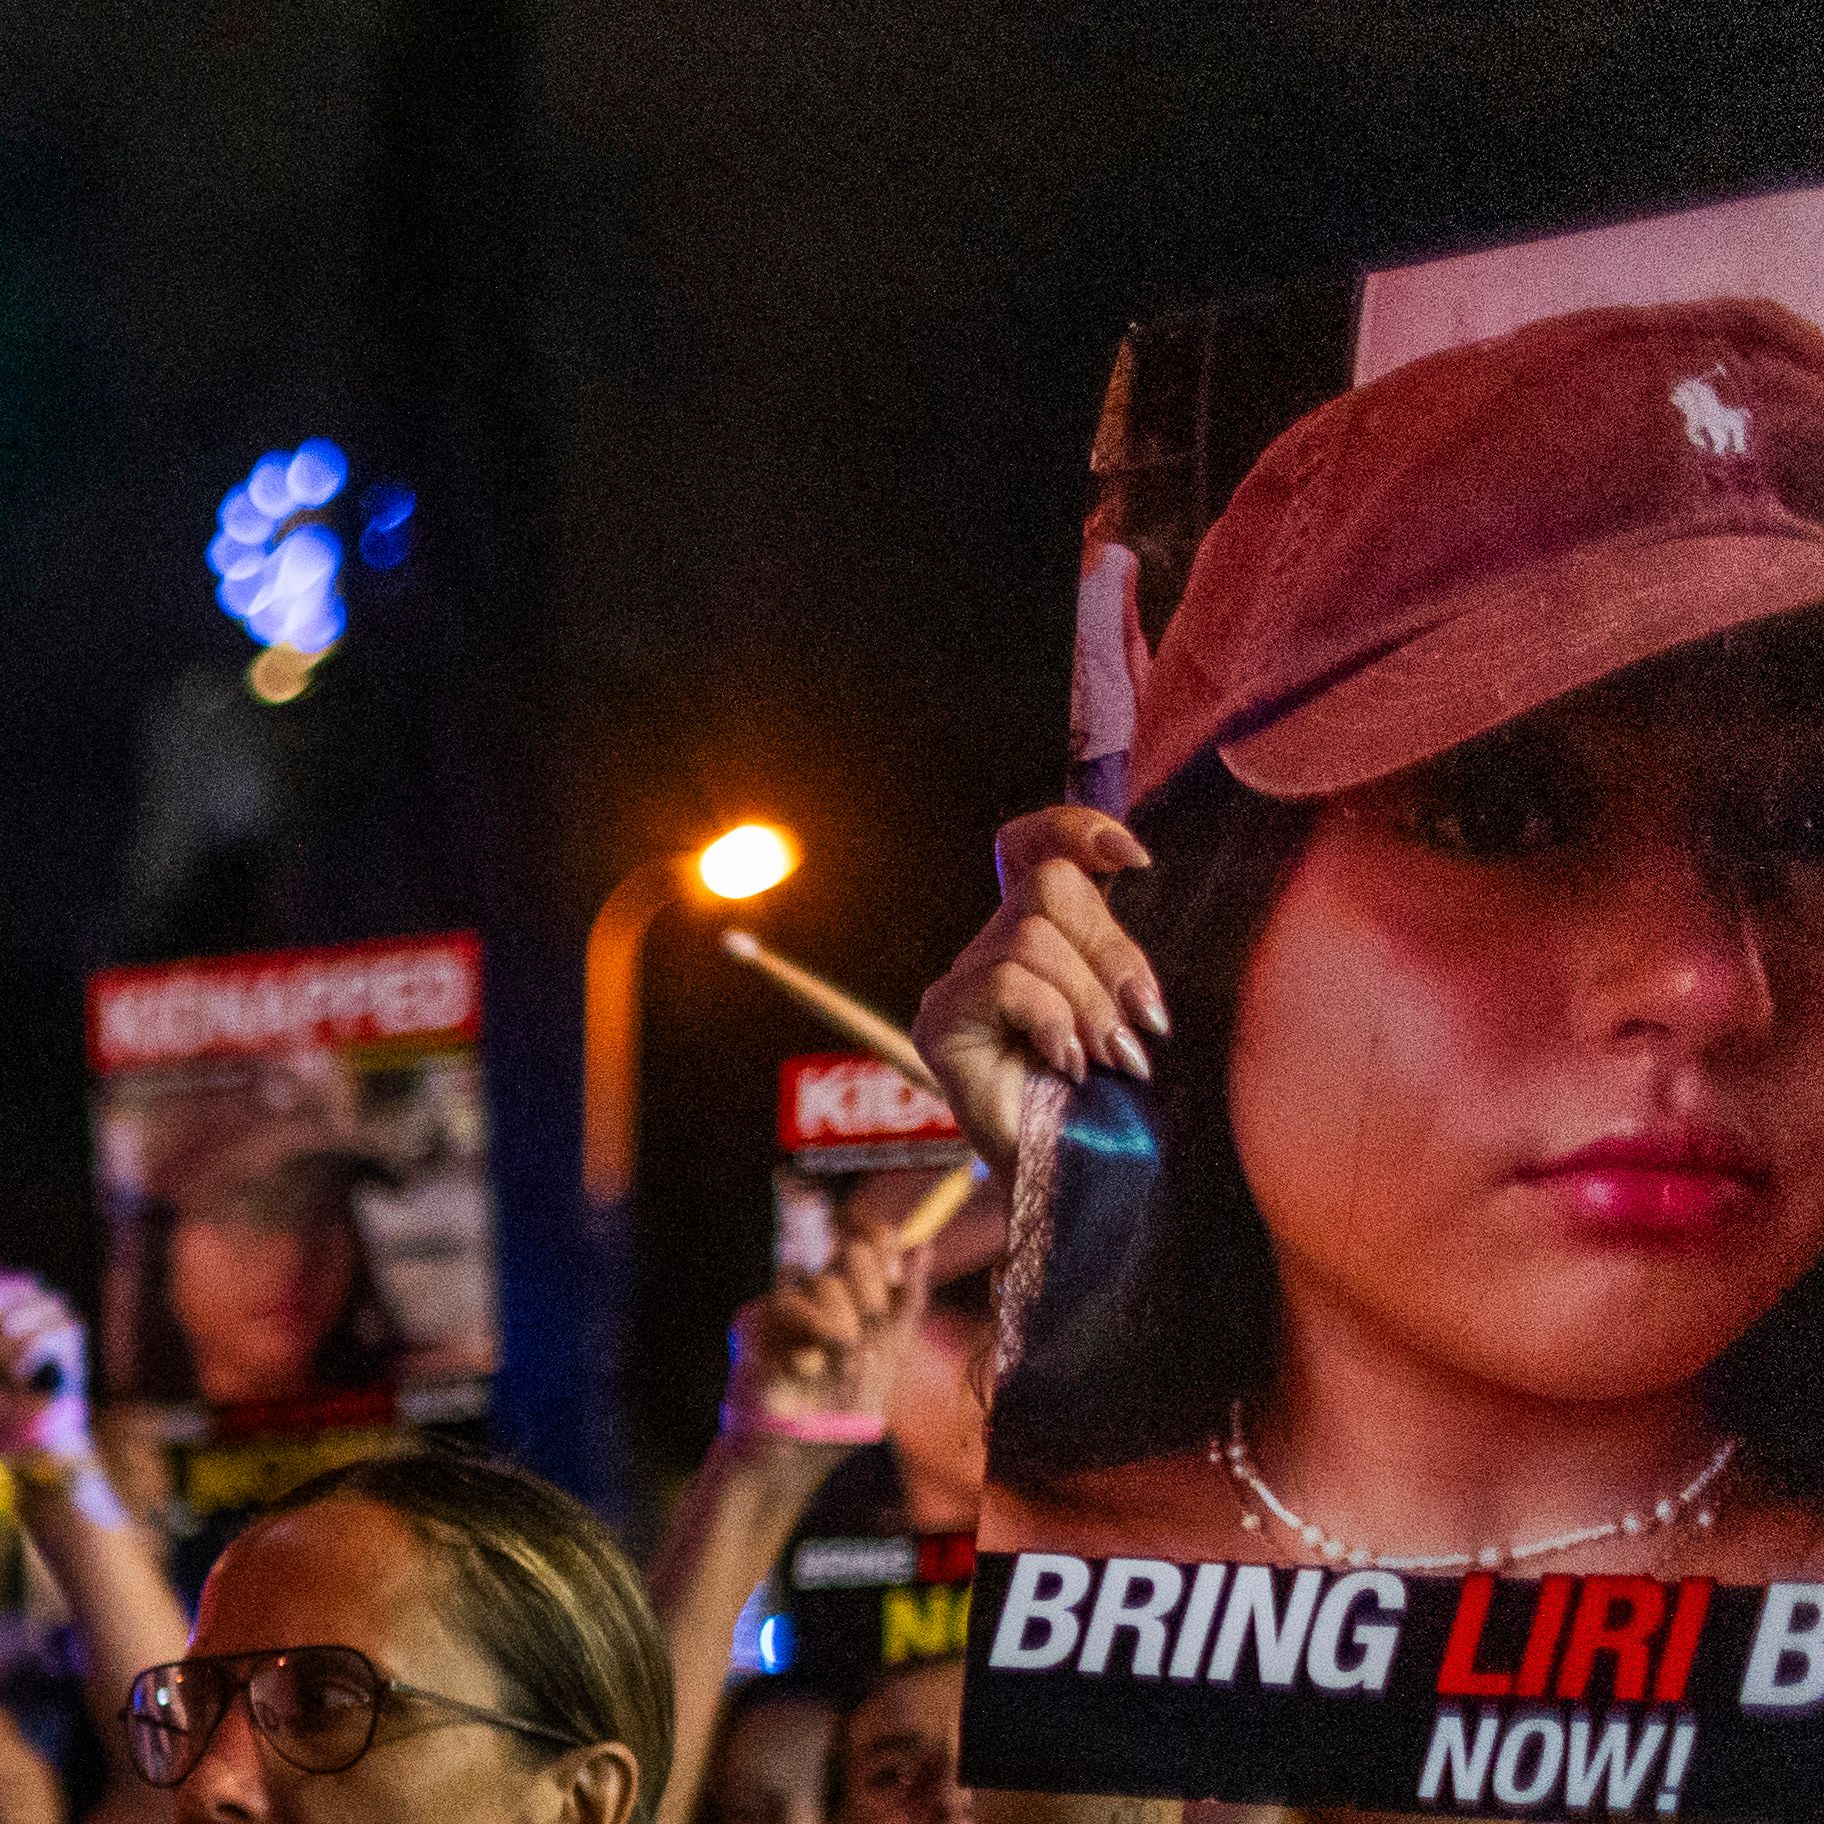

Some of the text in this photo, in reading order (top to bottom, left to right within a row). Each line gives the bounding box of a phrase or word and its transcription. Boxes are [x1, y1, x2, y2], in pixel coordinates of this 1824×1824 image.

[987, 1551, 1407, 1695] BRING
[1436, 1570, 1714, 1703] LIRI
[1416, 1712, 1697, 1813] NOW!
